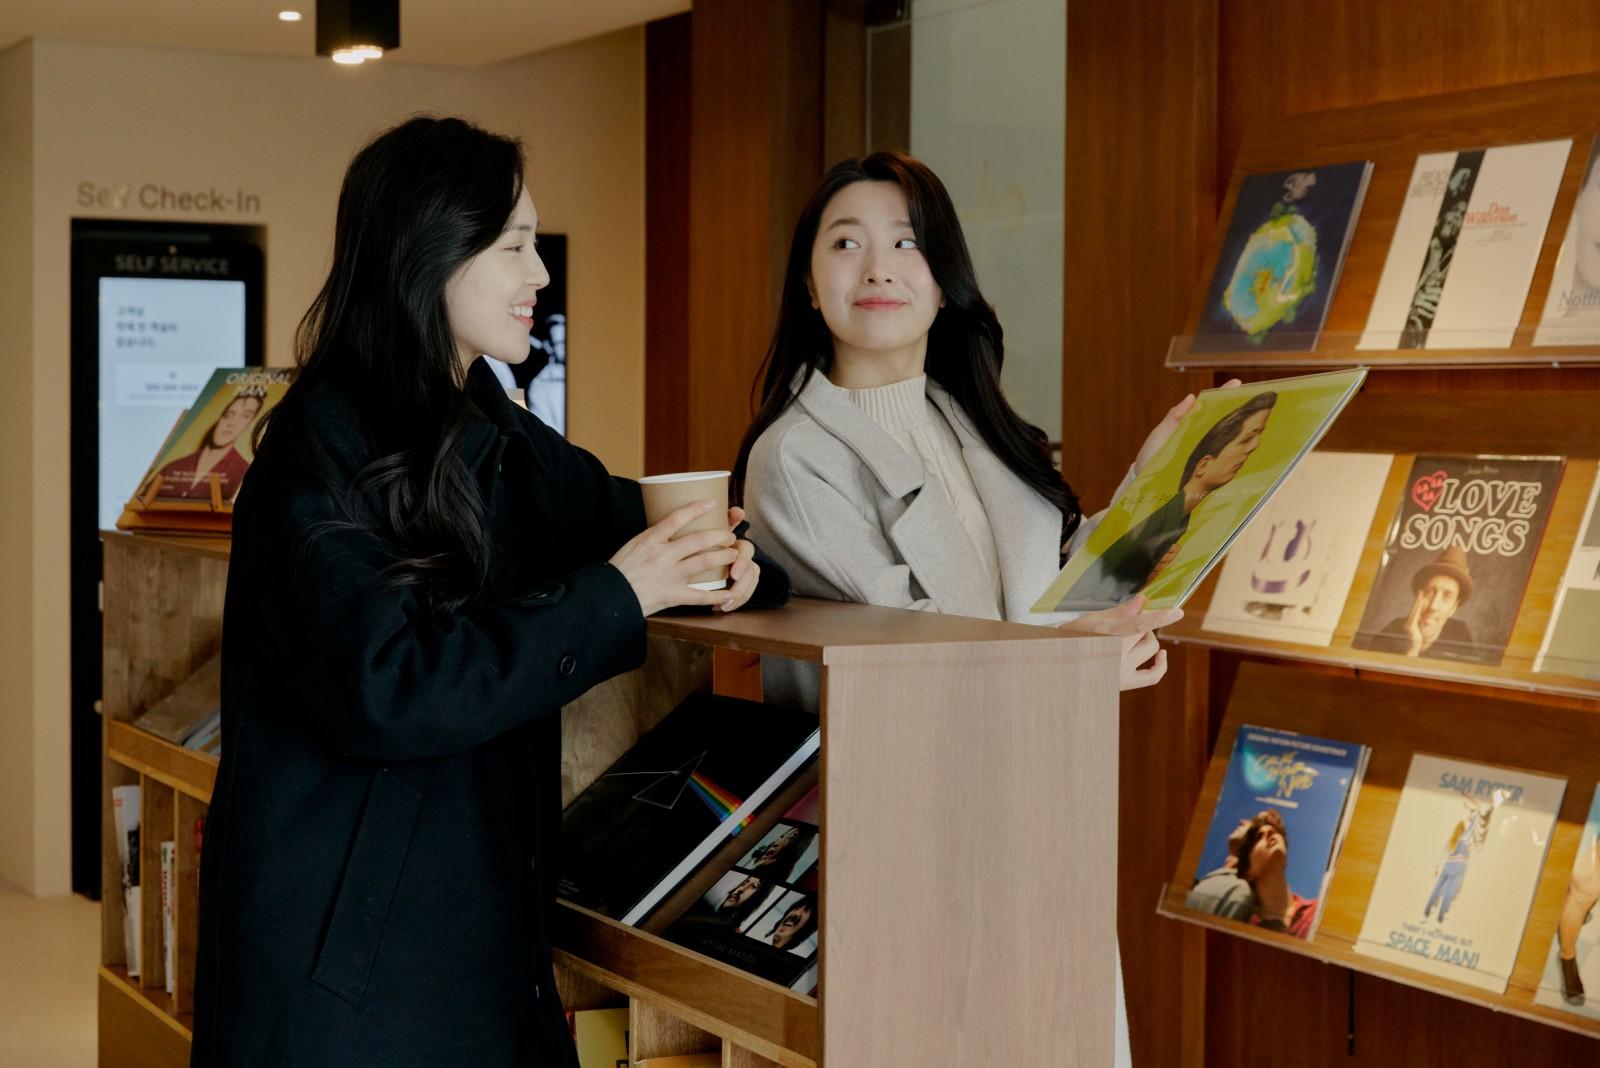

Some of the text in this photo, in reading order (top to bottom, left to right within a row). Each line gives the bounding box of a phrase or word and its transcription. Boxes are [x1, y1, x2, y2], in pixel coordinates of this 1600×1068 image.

[138, 184, 262, 213] Check-In
[115, 255, 230, 275] SELF SERVICE
[226, 372, 292, 385] ORIGINAL
[1434, 478, 1542, 518] LOVE
[1400, 513, 1530, 557] SONGS
[1439, 772, 1472, 792] SAM
[1386, 929, 1480, 970] SPACE MAN!
